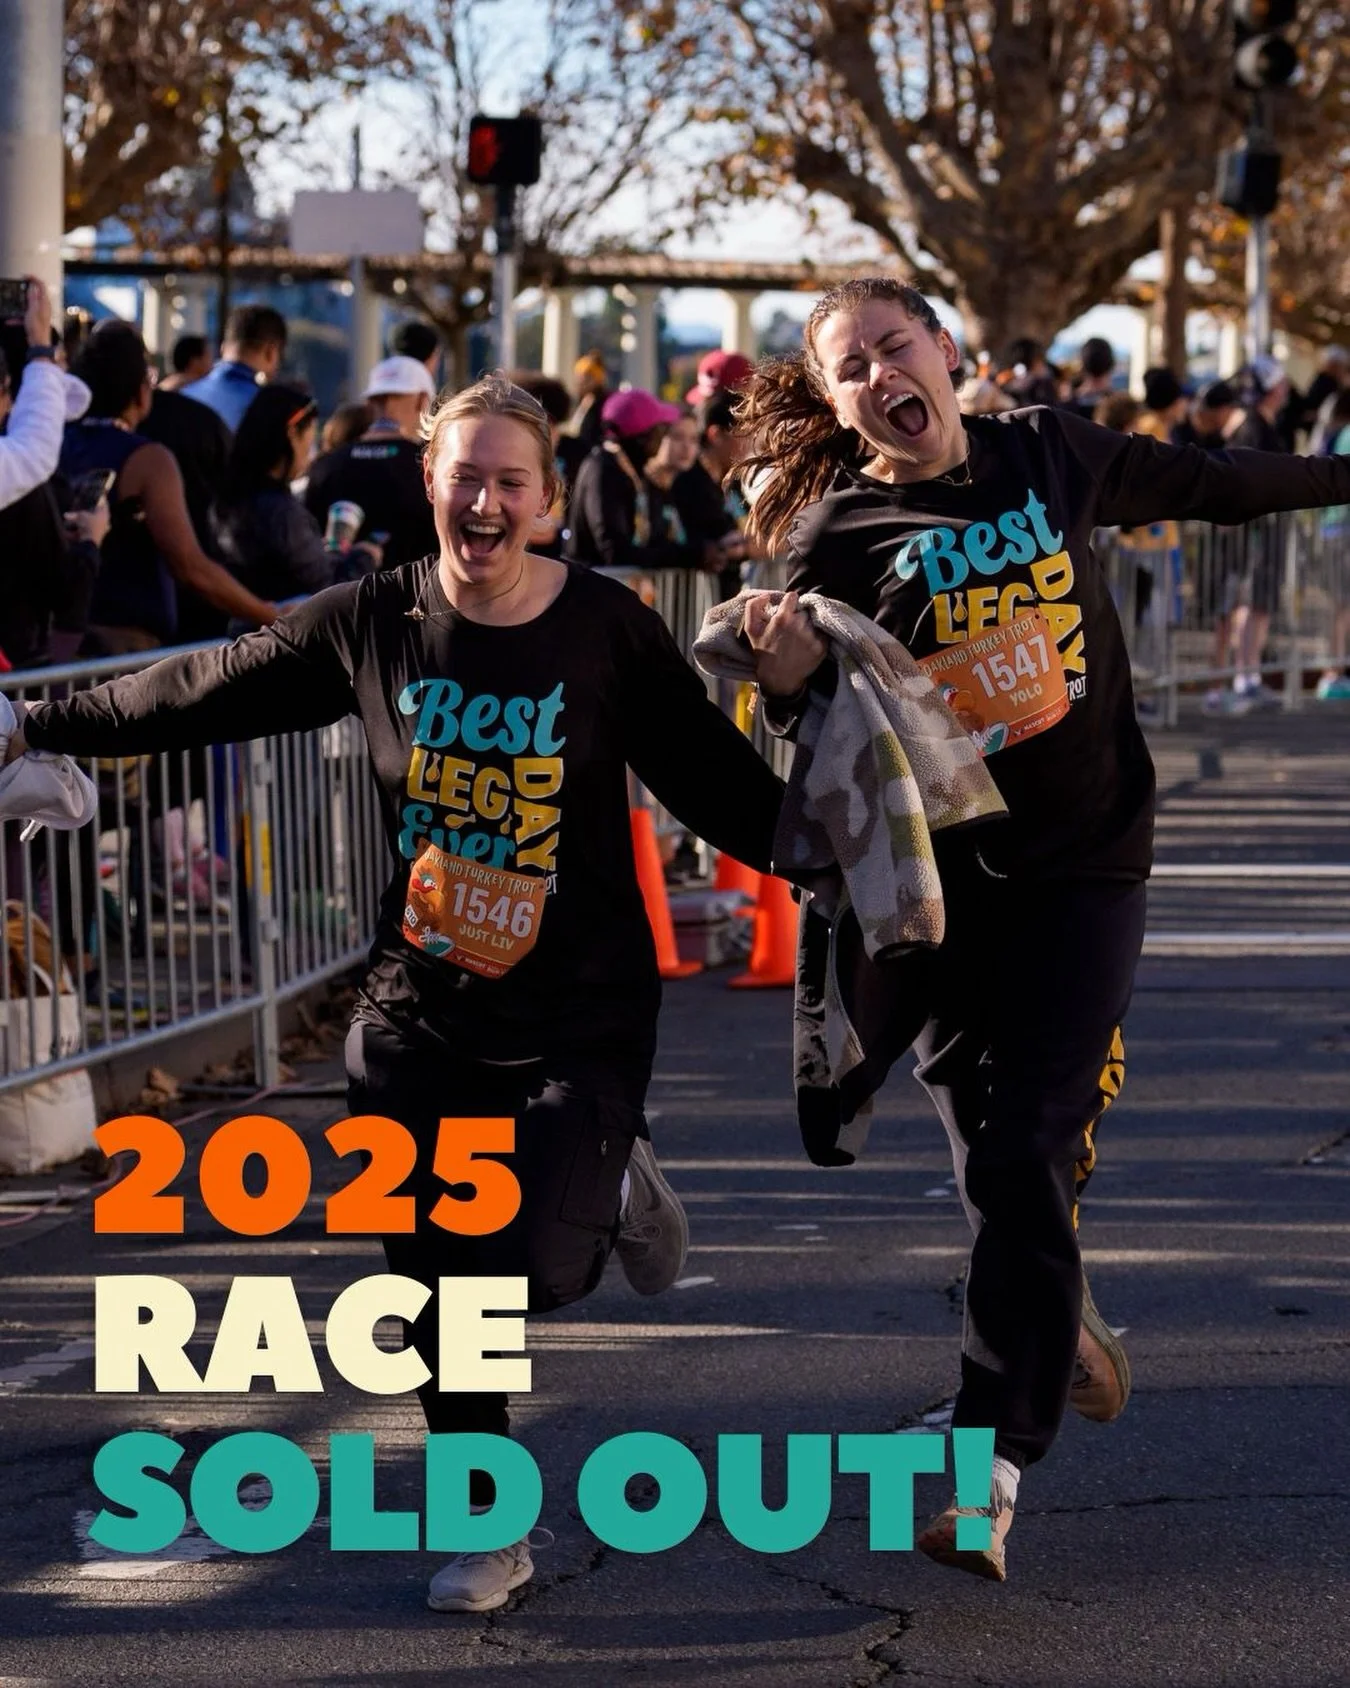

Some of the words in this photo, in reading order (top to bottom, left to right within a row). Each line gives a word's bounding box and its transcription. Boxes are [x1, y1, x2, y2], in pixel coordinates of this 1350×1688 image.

[895, 488, 1063, 597] Best
[1030, 551, 1086, 674] DAY
[922, 648, 968, 677] OAKLAND
[967, 631, 1008, 658] TURKEY
[1008, 617, 1037, 643] TROT
[971, 634, 1050, 699] 1547
[398, 677, 566, 756] Best
[1009, 683, 1043, 707] YOLO
[407, 747, 512, 822] LEG
[513, 757, 565, 871] DAY
[398, 803, 516, 870] Ever
[425, 849, 463, 877] OAKLAND
[465, 865, 507, 889] TURKEY
[507, 876, 537, 897] TROT
[545, 873, 558, 895] OT
[453, 882, 535, 938] 1546
[459, 923, 490, 944] JUST
[490, 935, 515, 951] LIV
